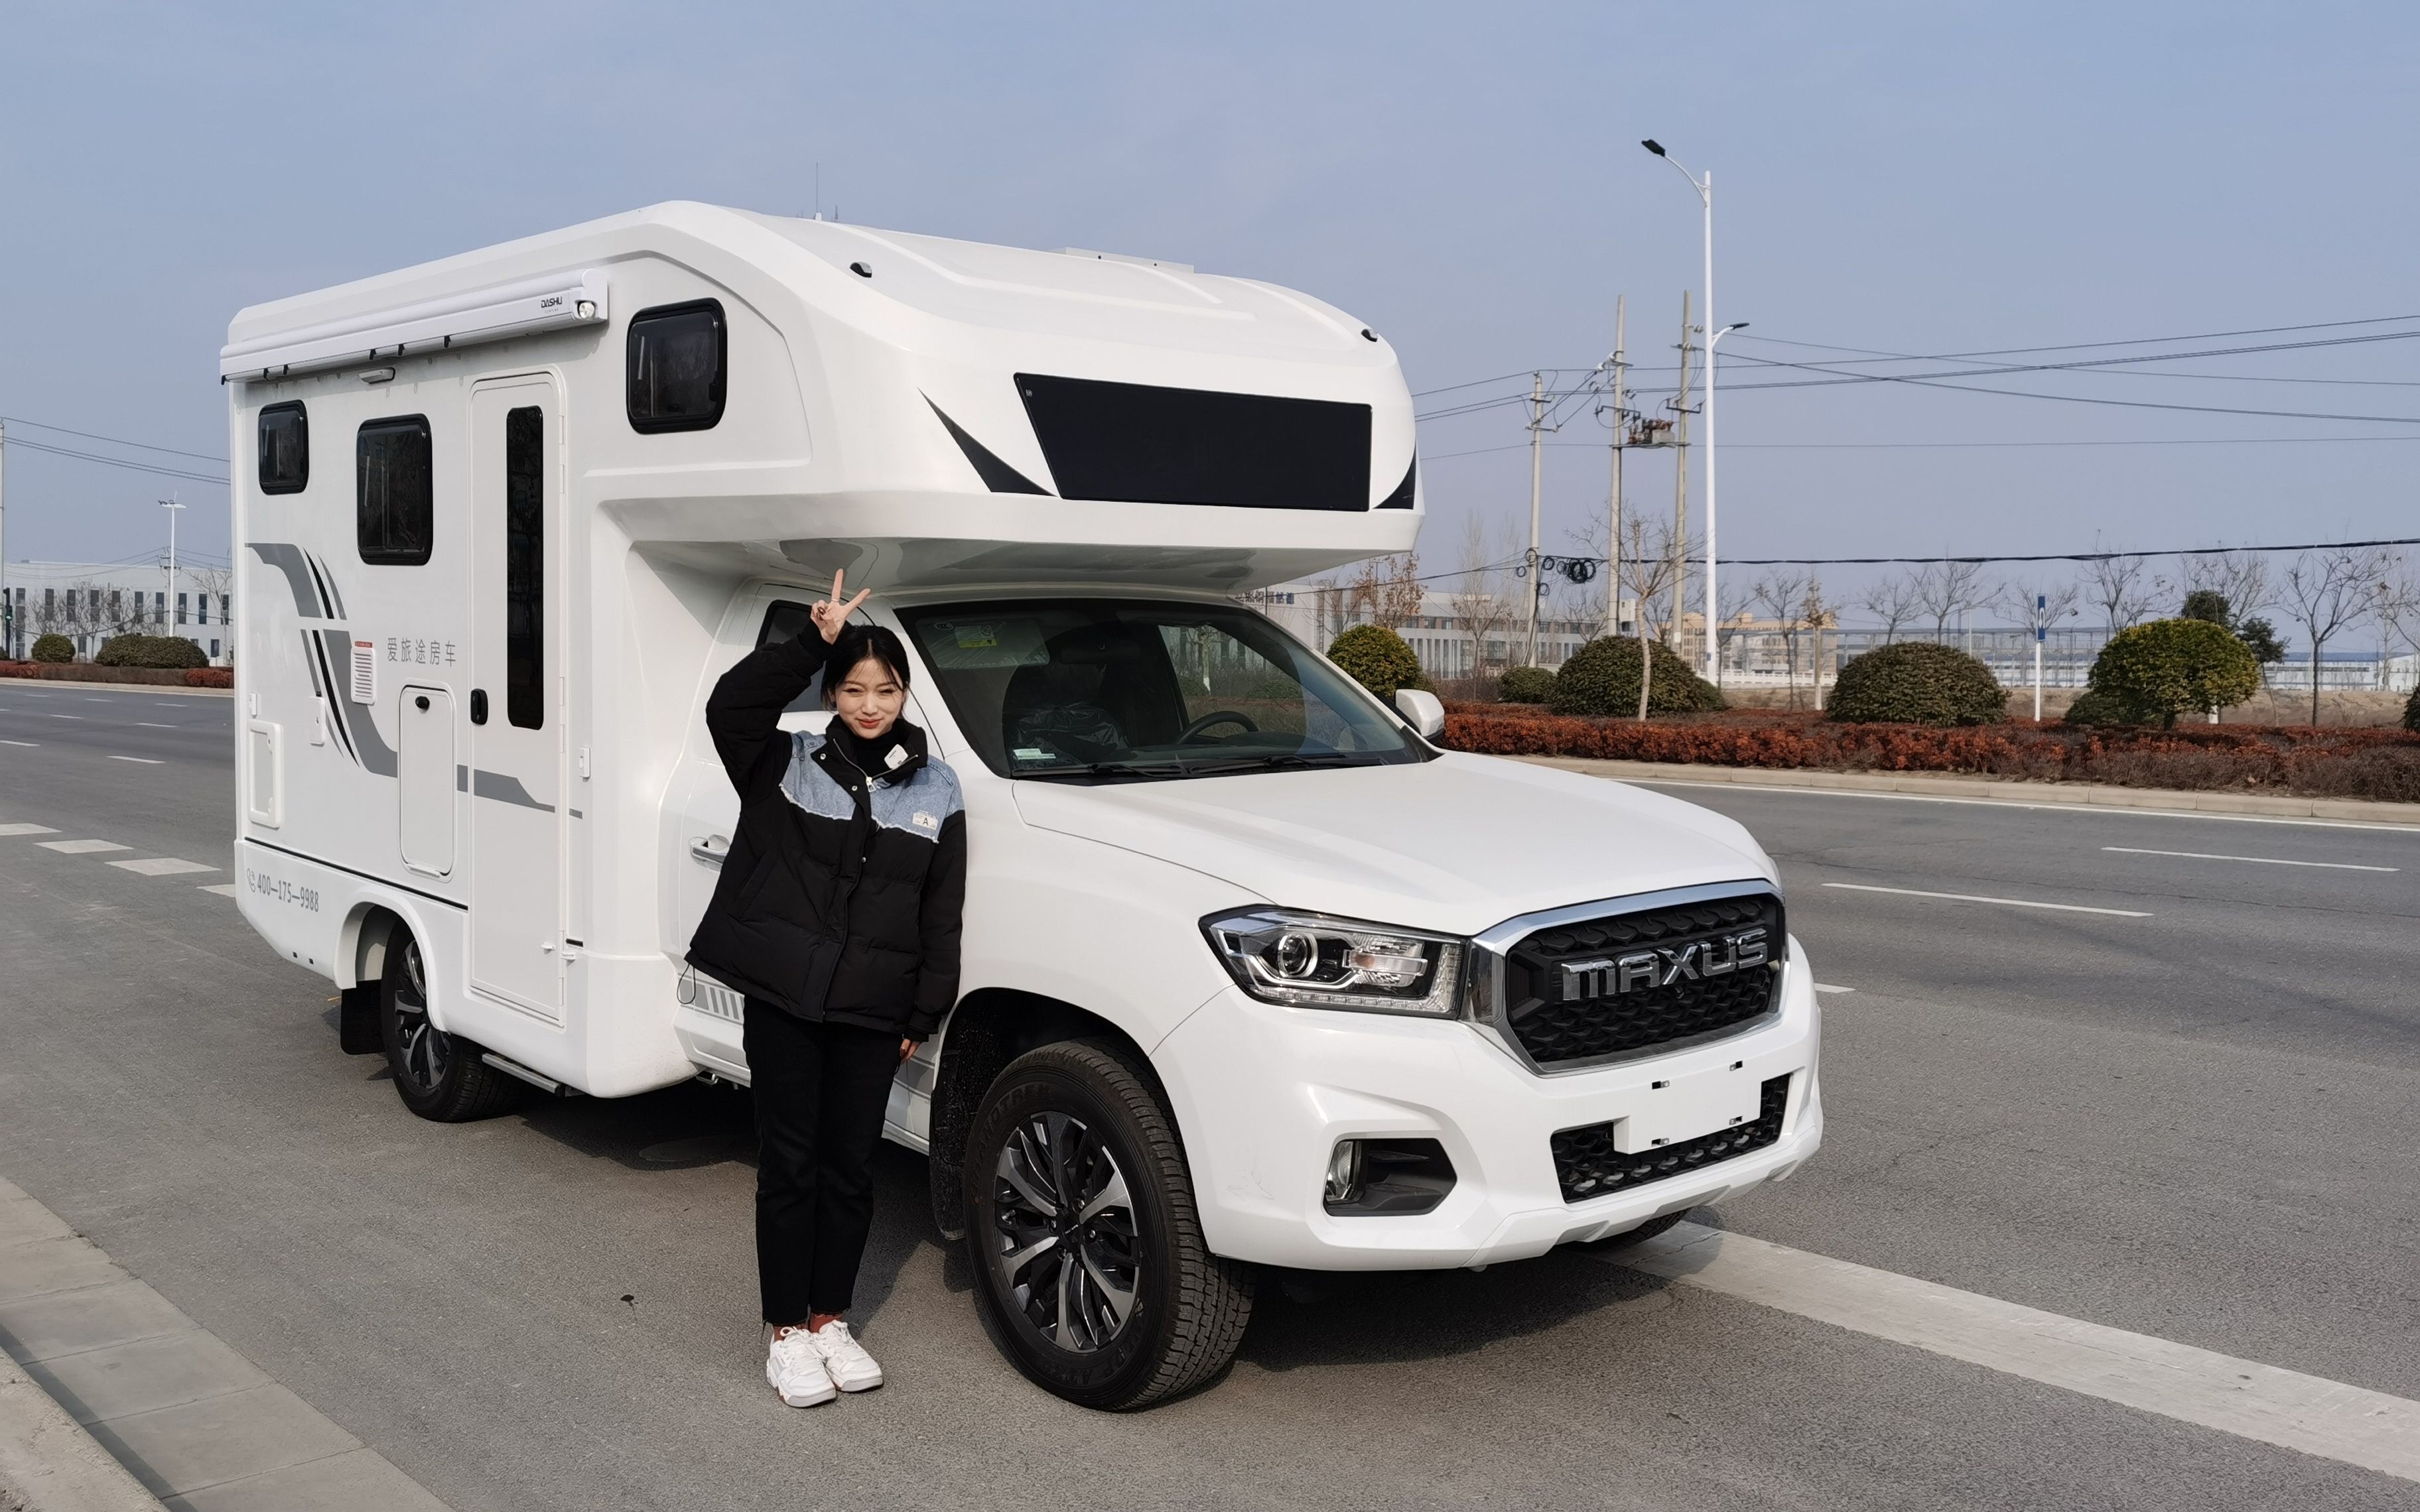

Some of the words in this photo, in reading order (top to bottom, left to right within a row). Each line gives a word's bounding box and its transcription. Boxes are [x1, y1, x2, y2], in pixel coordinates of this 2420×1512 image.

[541, 296, 563, 308] DASHU
[387, 637, 456, 667] 爱旅途房车
[922, 817, 929, 826] A
[1561, 928, 1767, 1001] MAXUS
